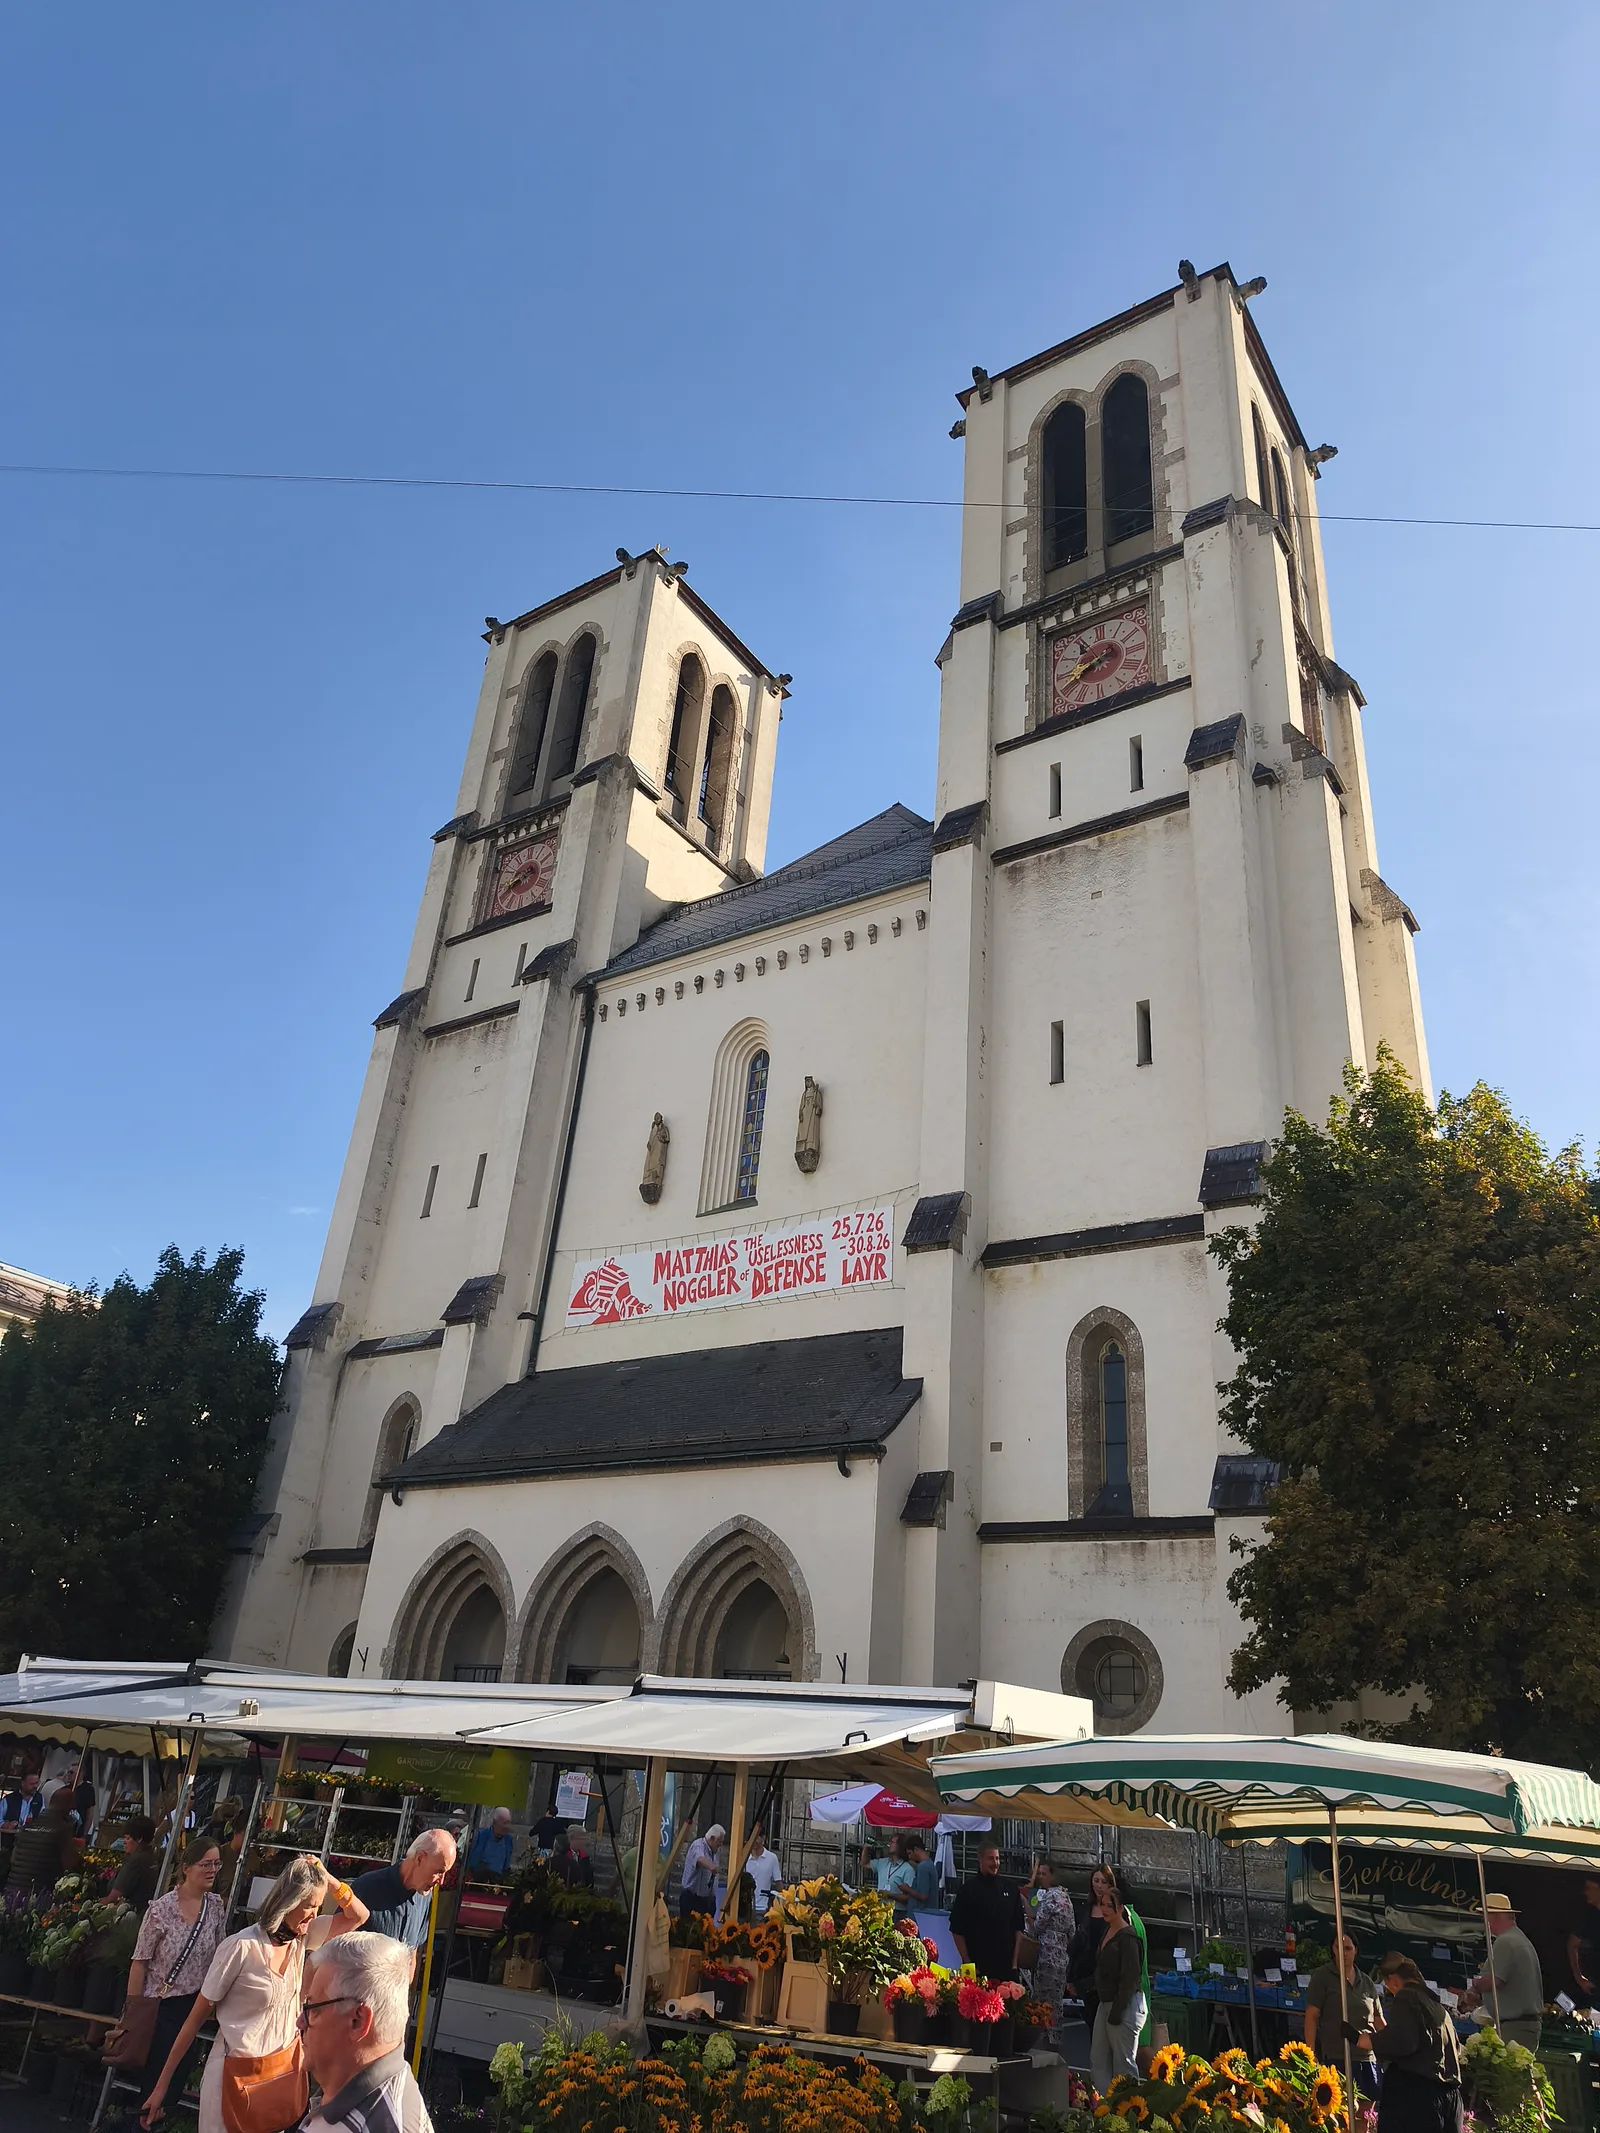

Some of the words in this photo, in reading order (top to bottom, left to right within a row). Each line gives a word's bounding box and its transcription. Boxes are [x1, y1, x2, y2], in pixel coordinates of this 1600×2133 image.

[743, 1233, 764, 1251] THE
[831, 1211, 885, 1240] 25.7.26
[653, 1239, 739, 1285] MATTHIAS
[749, 1233, 824, 1267] USELESSNESS
[740, 1268, 750, 1282] OF
[751, 1251, 827, 1299] DEFENSE
[841, 1252, 888, 1286] LAYR
[663, 1266, 741, 1311] NOGGLER
